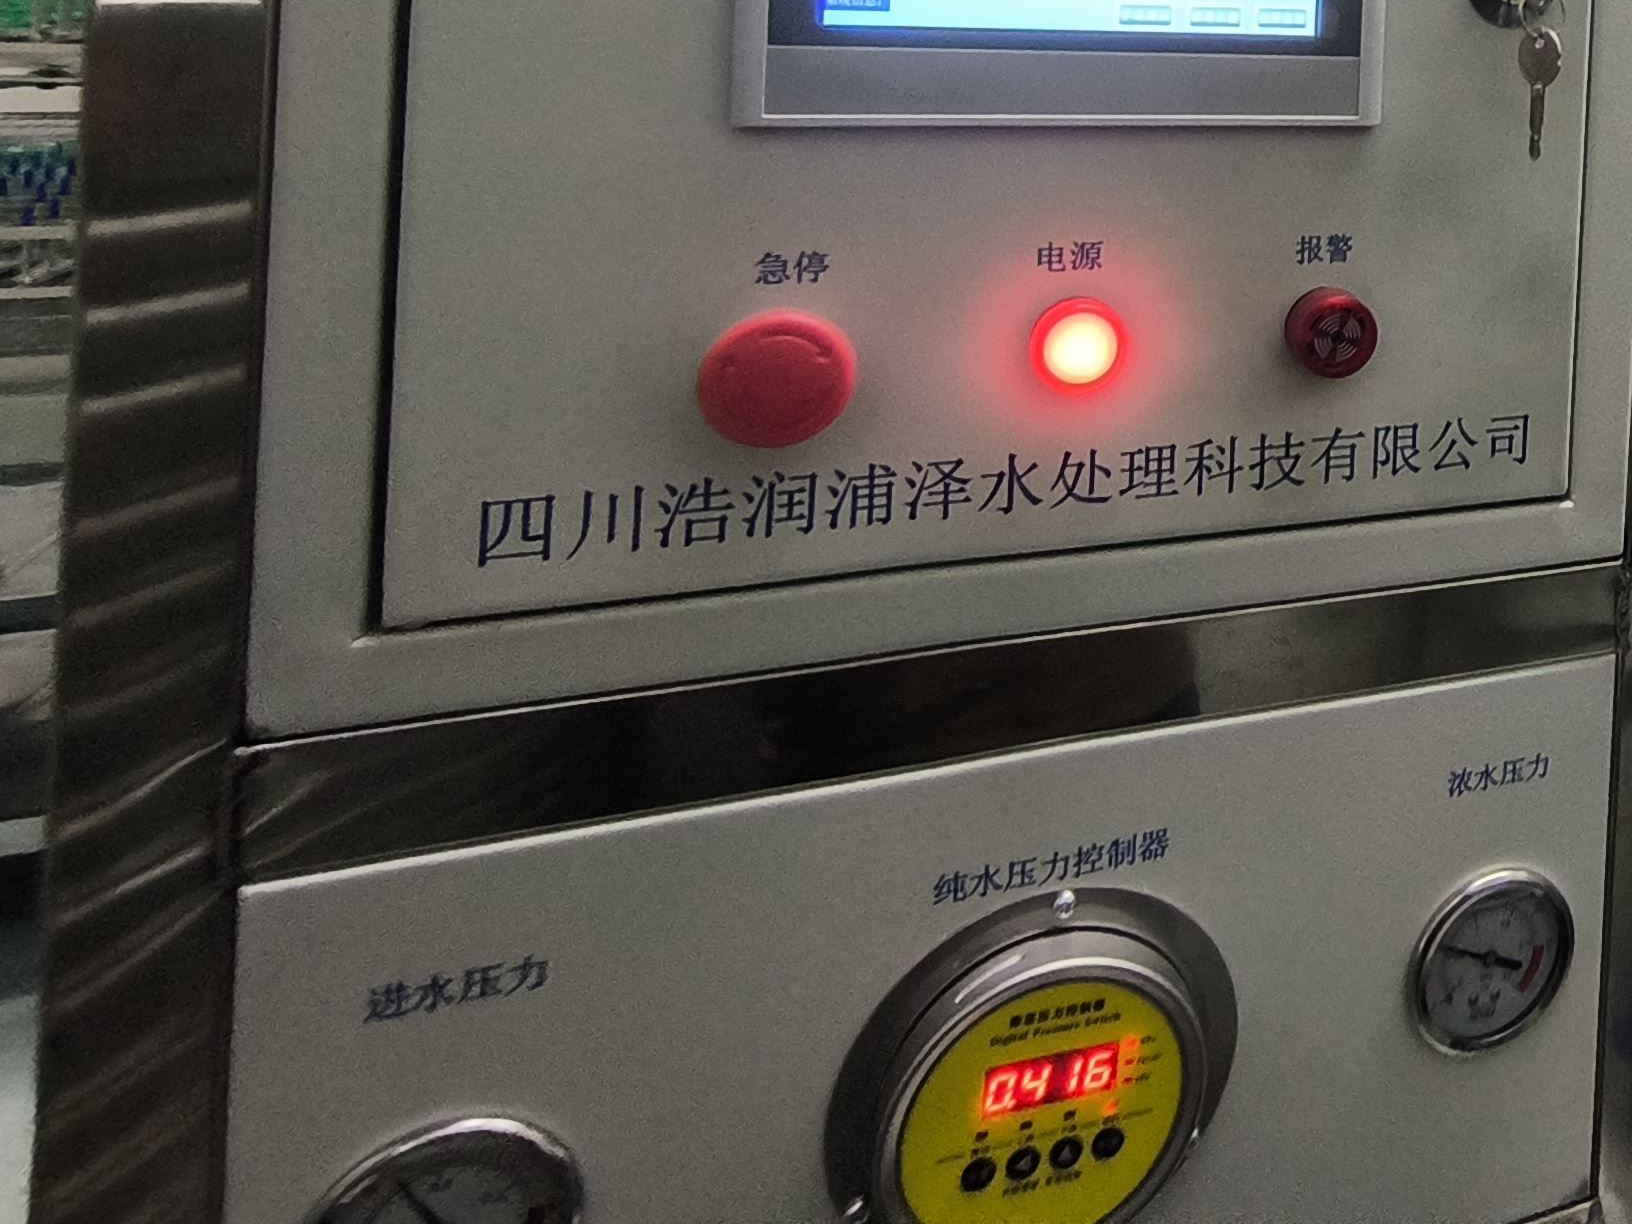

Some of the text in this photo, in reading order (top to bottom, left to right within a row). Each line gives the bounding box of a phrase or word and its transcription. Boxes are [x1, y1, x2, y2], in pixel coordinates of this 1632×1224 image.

[753, 250, 831, 285] 急停
[1036, 239, 1104, 274] 电源
[1296, 234, 1354, 266] 报警
[476, 412, 1532, 568] 四川浩润浦泽水处理科技有限公司
[1447, 752, 1551, 798] 浓水压力
[932, 827, 1171, 906] 纯水压力控制器
[362, 953, 550, 1024] 进水压力
